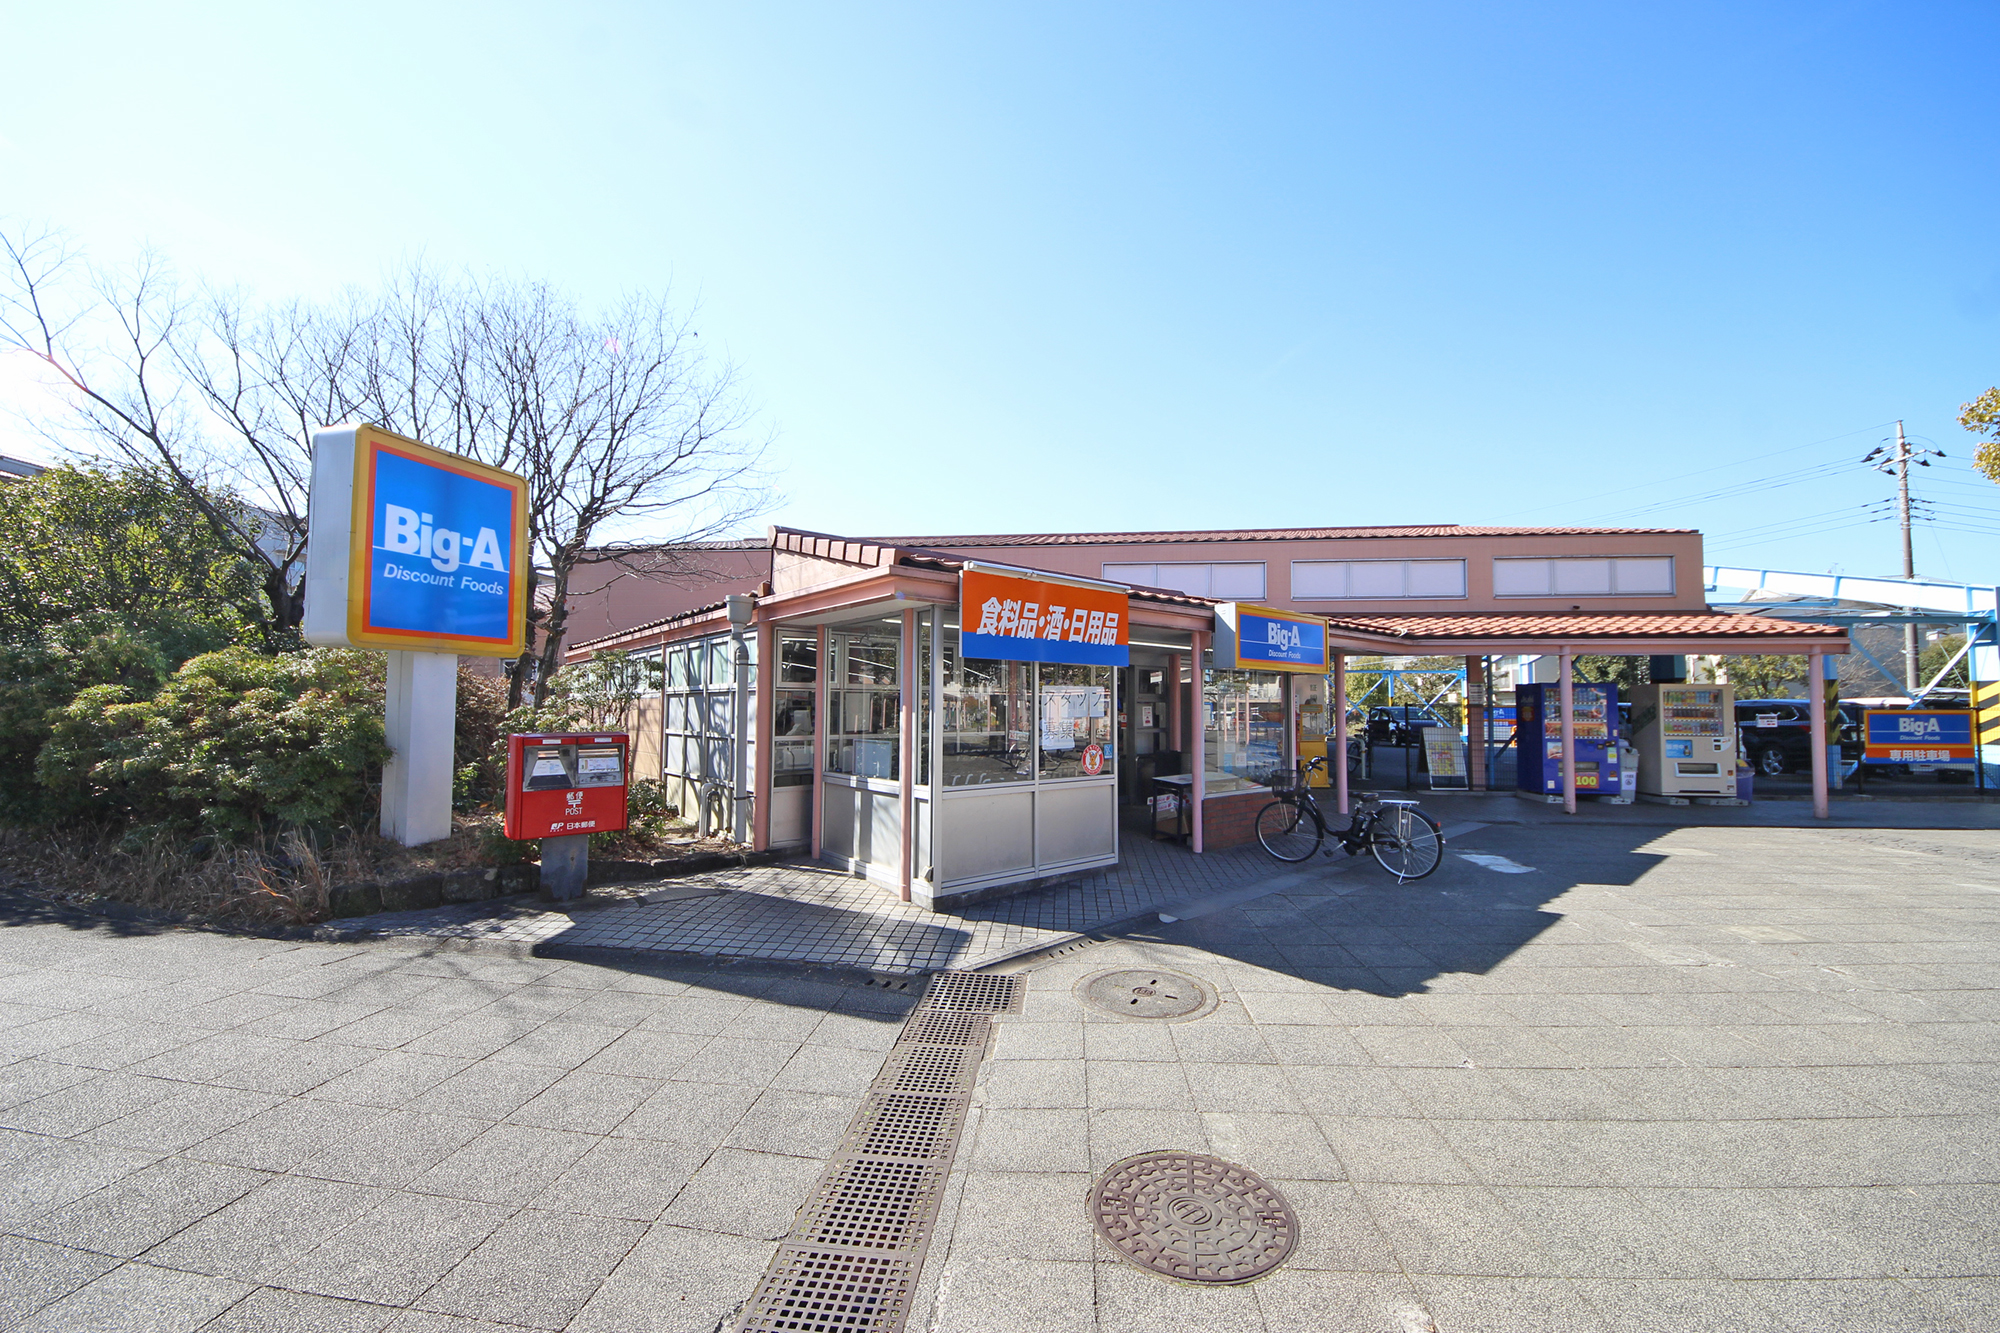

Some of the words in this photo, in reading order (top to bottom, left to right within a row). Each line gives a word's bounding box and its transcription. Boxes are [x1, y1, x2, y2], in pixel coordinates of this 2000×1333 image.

[384, 503, 505, 573] Big-A
[383, 563, 455, 588] Discount
[460, 576, 504, 595] Foods
[976, 597, 1119, 647] 食料品・酒・日用品
[1268, 622, 1301, 651] Big-A
[1268, 649, 1288, 658] Discount
[1288, 651, 1301, 659] Foods
[1898, 718, 1941, 736] Big-A
[1889, 749, 1951, 762] 専用駐車場
[1575, 776, 1597, 786] 100
[566, 791, 584, 801] 郵便
[565, 807, 583, 816] POST
[566, 820, 596, 830] 日本郵便
